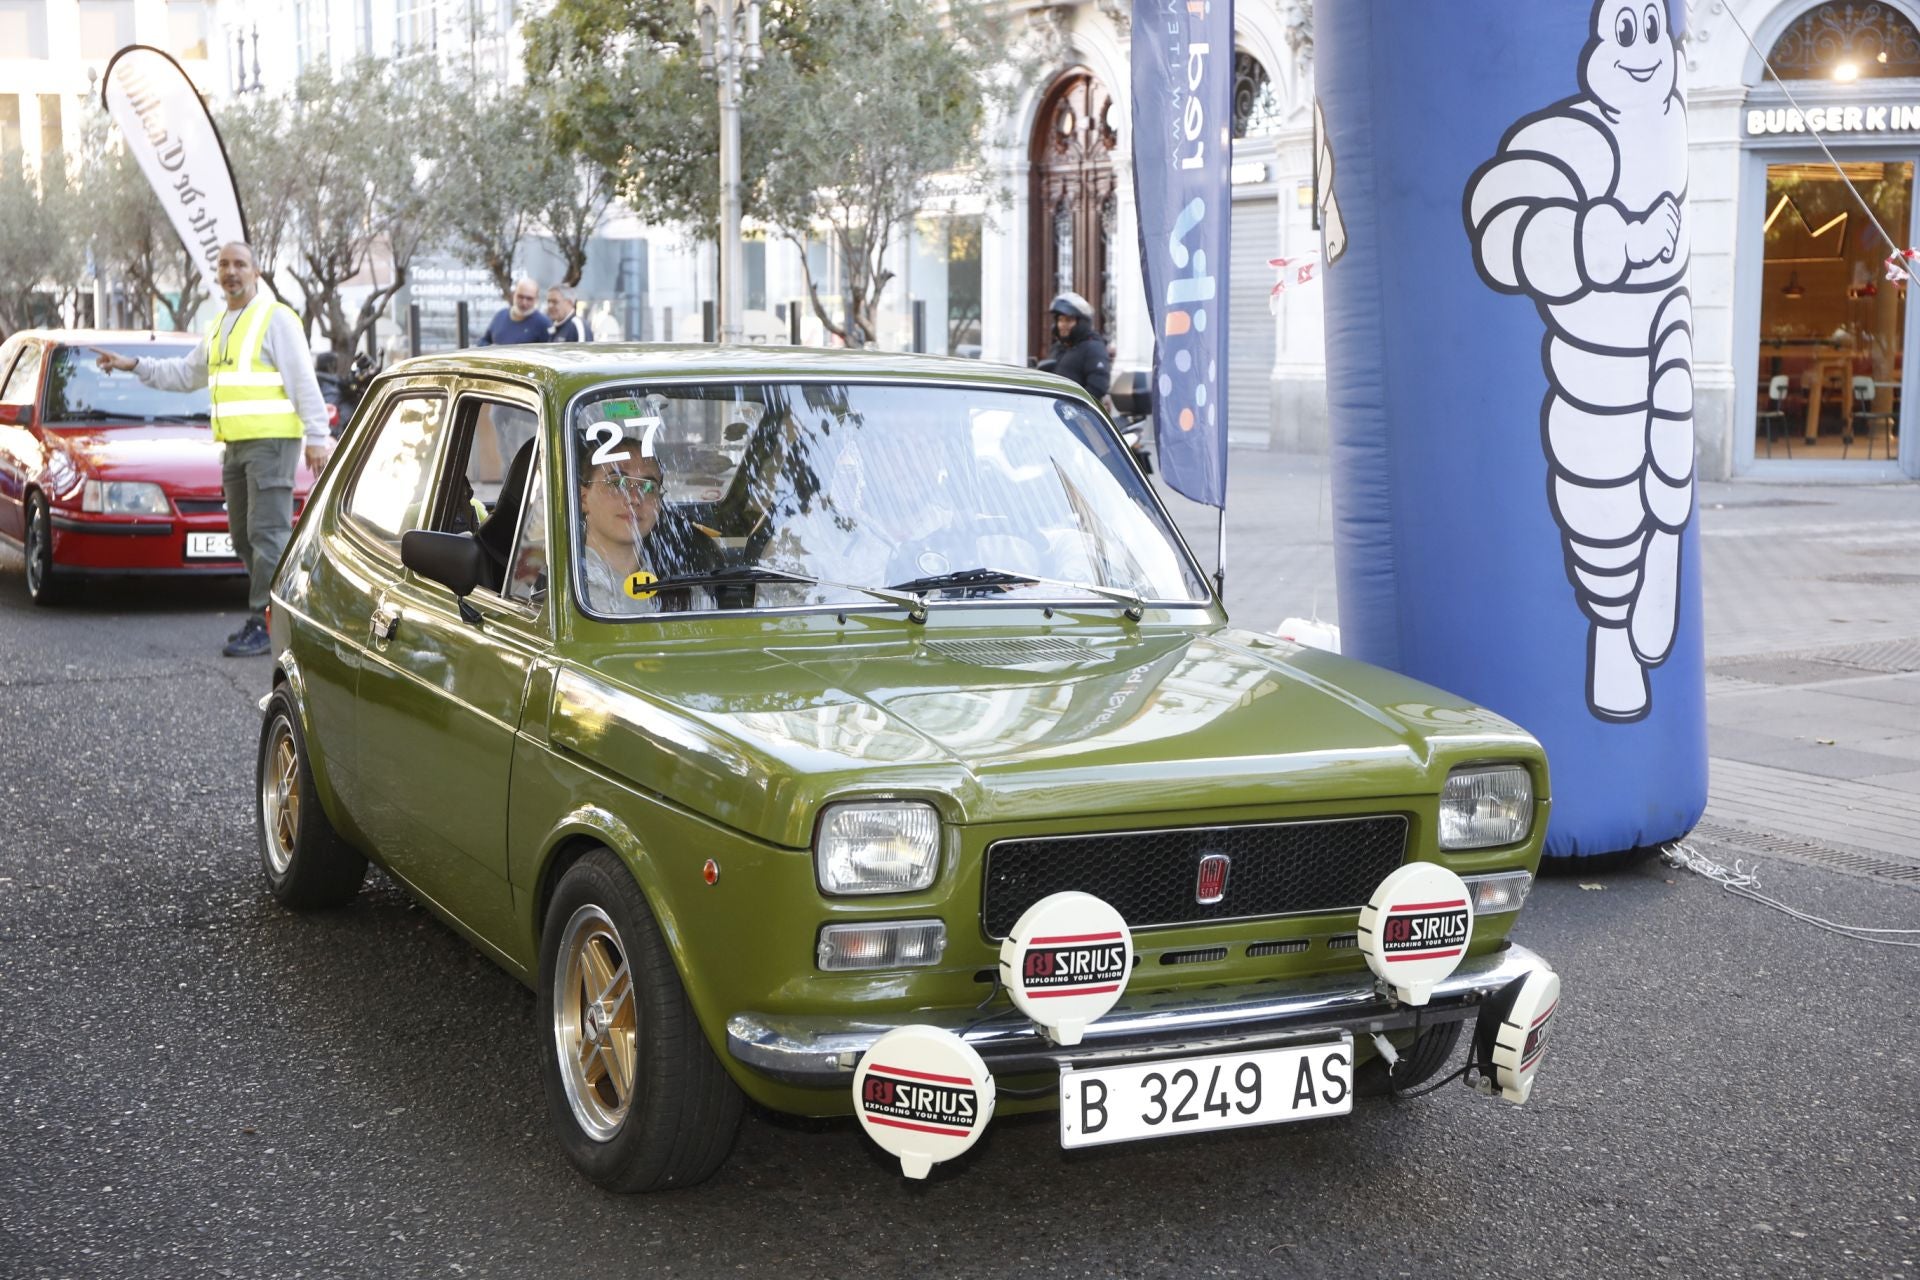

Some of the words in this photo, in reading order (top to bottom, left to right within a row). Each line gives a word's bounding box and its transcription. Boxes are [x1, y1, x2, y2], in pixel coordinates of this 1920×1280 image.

[1747, 105, 1864, 135] BURGER
[410, 265, 444, 280] Todo
[585, 415, 661, 466] 27
[1410, 913, 1467, 941] SIRIUS
[1385, 941, 1422, 949] EXPLORING
[1444, 936, 1465, 944] VISION
[1055, 947, 1124, 976] SIRIUS
[1025, 976, 1069, 985] EXPLORING
[1073, 974, 1093, 982] YOUR
[1097, 971, 1123, 980] VISION
[895, 1084, 974, 1117] SIRIUS
[1080, 1078, 1109, 1135] B
[1140, 1061, 1263, 1126] 3249
[1291, 1052, 1348, 1110] AS
[865, 1102, 911, 1116] EXPLORING
[915, 1111, 938, 1120] YOUR
[942, 1115, 973, 1124] VISION
